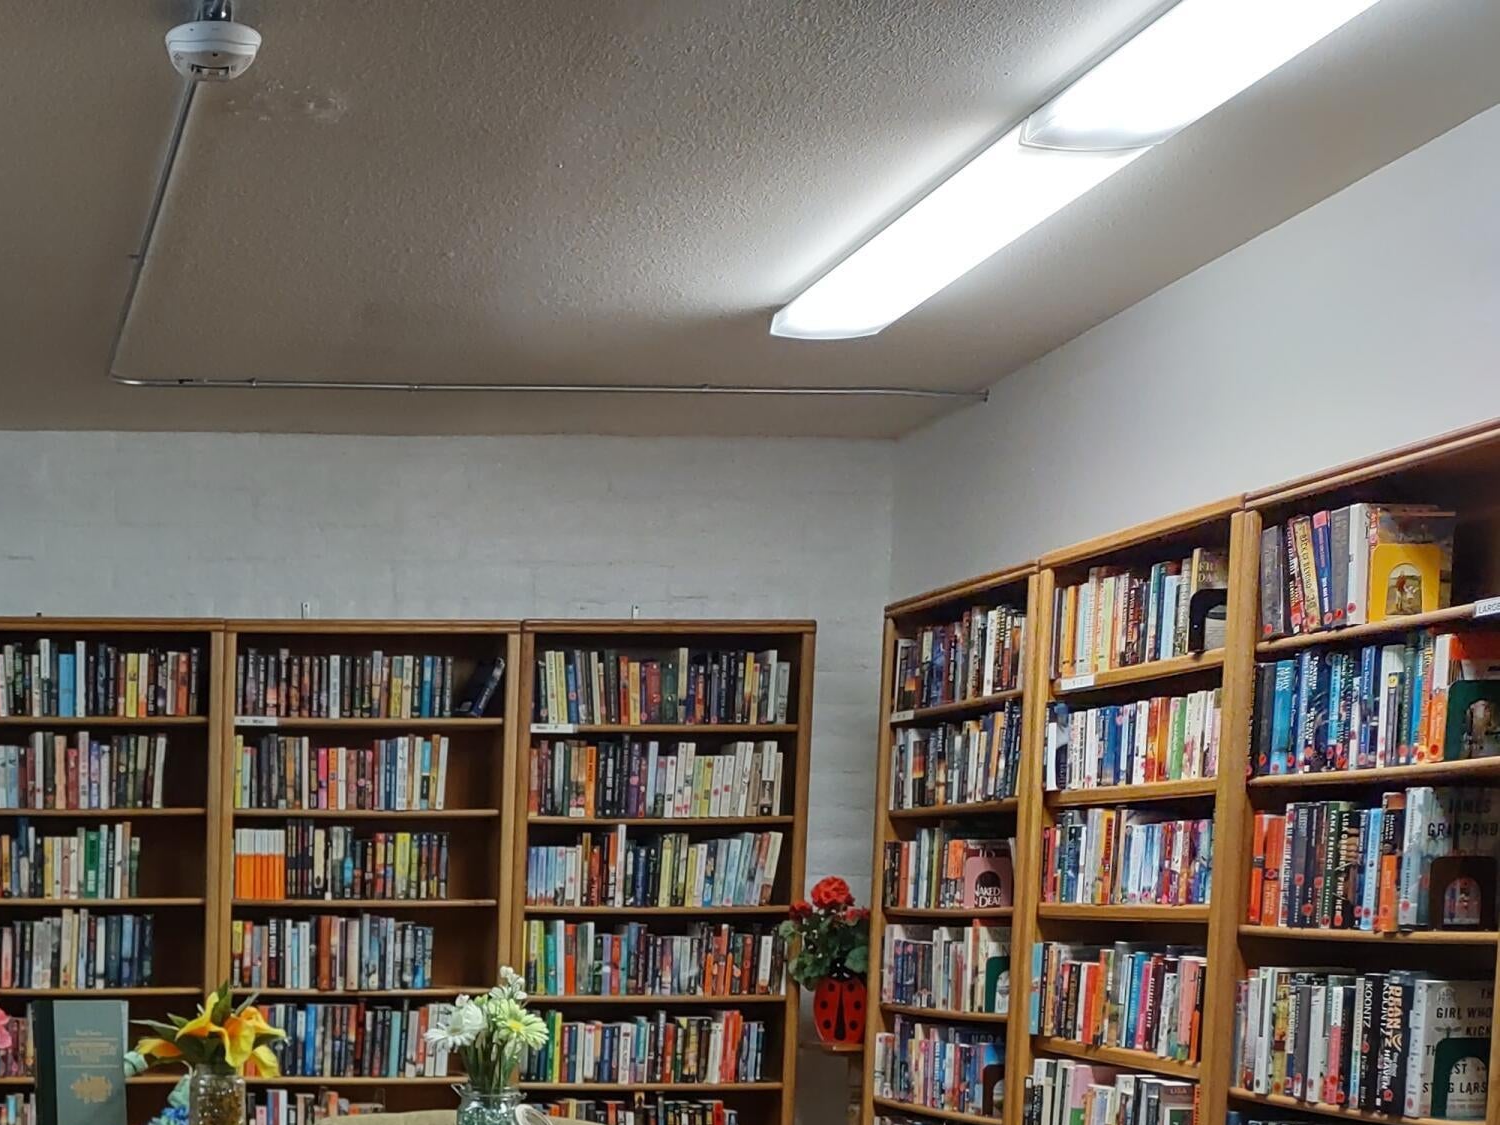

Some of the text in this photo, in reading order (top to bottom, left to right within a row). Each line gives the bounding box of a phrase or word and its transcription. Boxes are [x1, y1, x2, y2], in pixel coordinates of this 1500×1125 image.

[1299, 535, 1311, 588] BACK BEYOND
[1329, 809, 1337, 832] TANA
[1340, 813, 1349, 831] LISA
[1326, 837, 1335, 870] FRENCH
[1336, 877, 1344, 895] FIND
[1362, 984, 1373, 1027] KOONTZ
[1386, 986, 1395, 1038] KOONTZ
[1393, 987, 1403, 1029] DEAN
[1436, 1007, 1462, 1020] GIRL
[1382, 1050, 1391, 1089] HEAVEN
